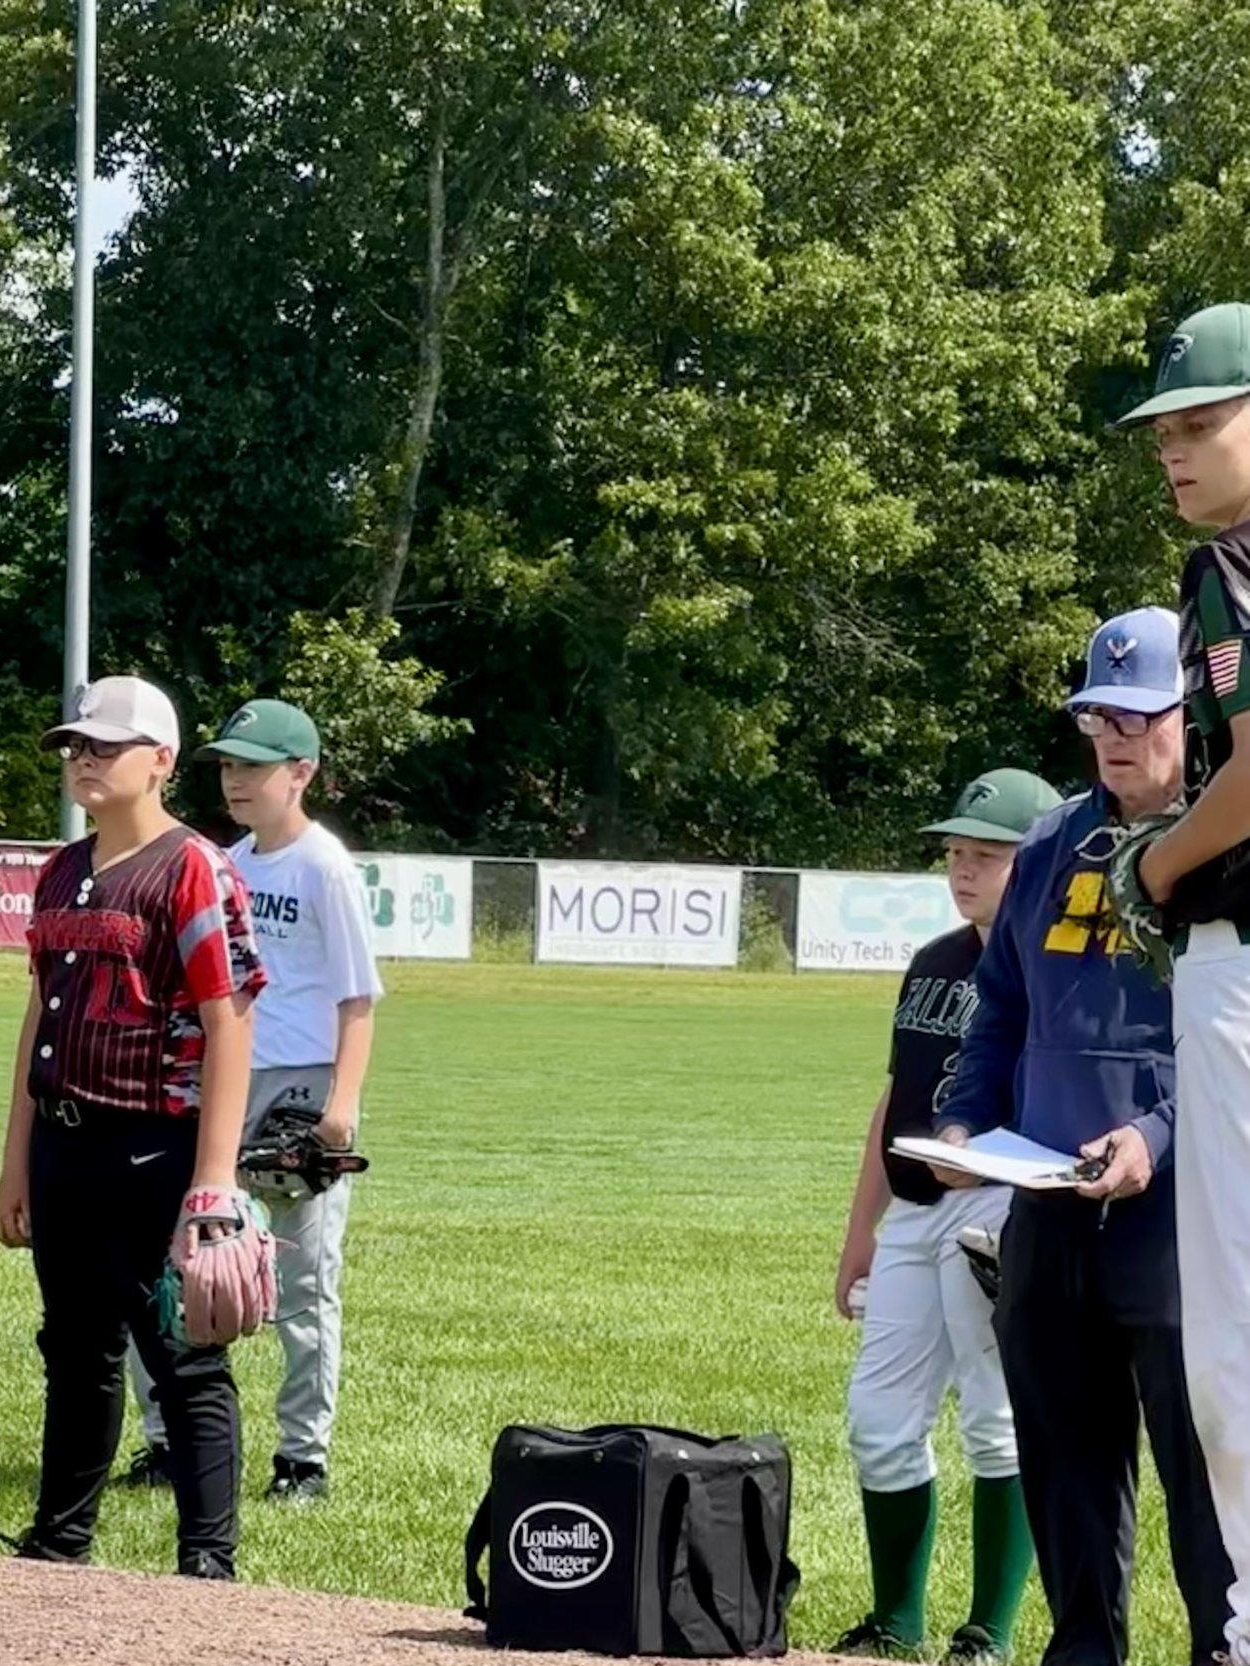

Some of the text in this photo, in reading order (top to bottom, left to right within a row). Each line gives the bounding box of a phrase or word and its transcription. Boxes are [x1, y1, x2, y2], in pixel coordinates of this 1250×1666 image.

[549, 884, 727, 937] MORISI
[801, 938, 847, 963] Unity
[851, 941, 894, 961] Tech
[521, 1521, 600, 1549] Louisville
[527, 1546, 591, 1578] Slugger
